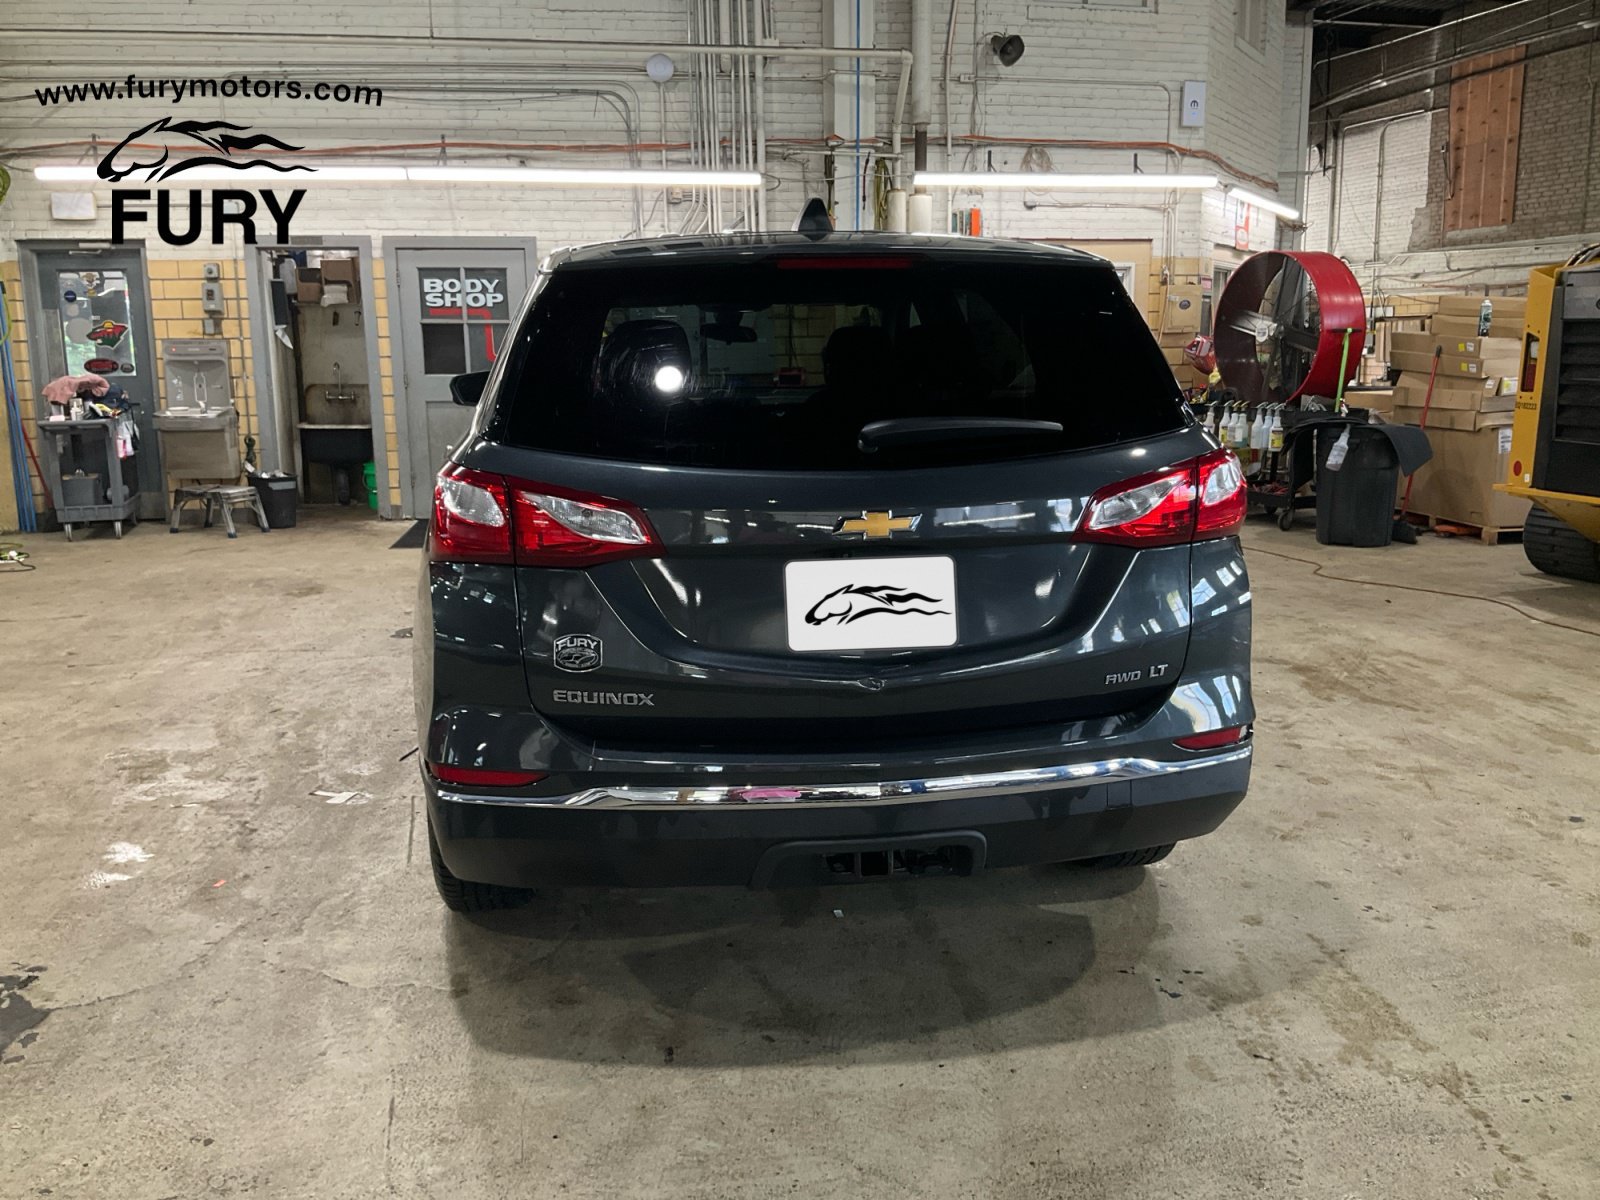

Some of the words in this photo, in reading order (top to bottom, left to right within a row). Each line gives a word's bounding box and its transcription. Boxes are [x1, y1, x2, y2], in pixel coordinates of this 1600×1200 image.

[423, 278, 499, 293] BODY
[425, 292, 504, 308] SHOP
[556, 637, 598, 651] FURY
[1105, 670, 1142, 685] AWD
[1149, 663, 1169, 679] LT
[552, 689, 655, 706] EQUINOX
